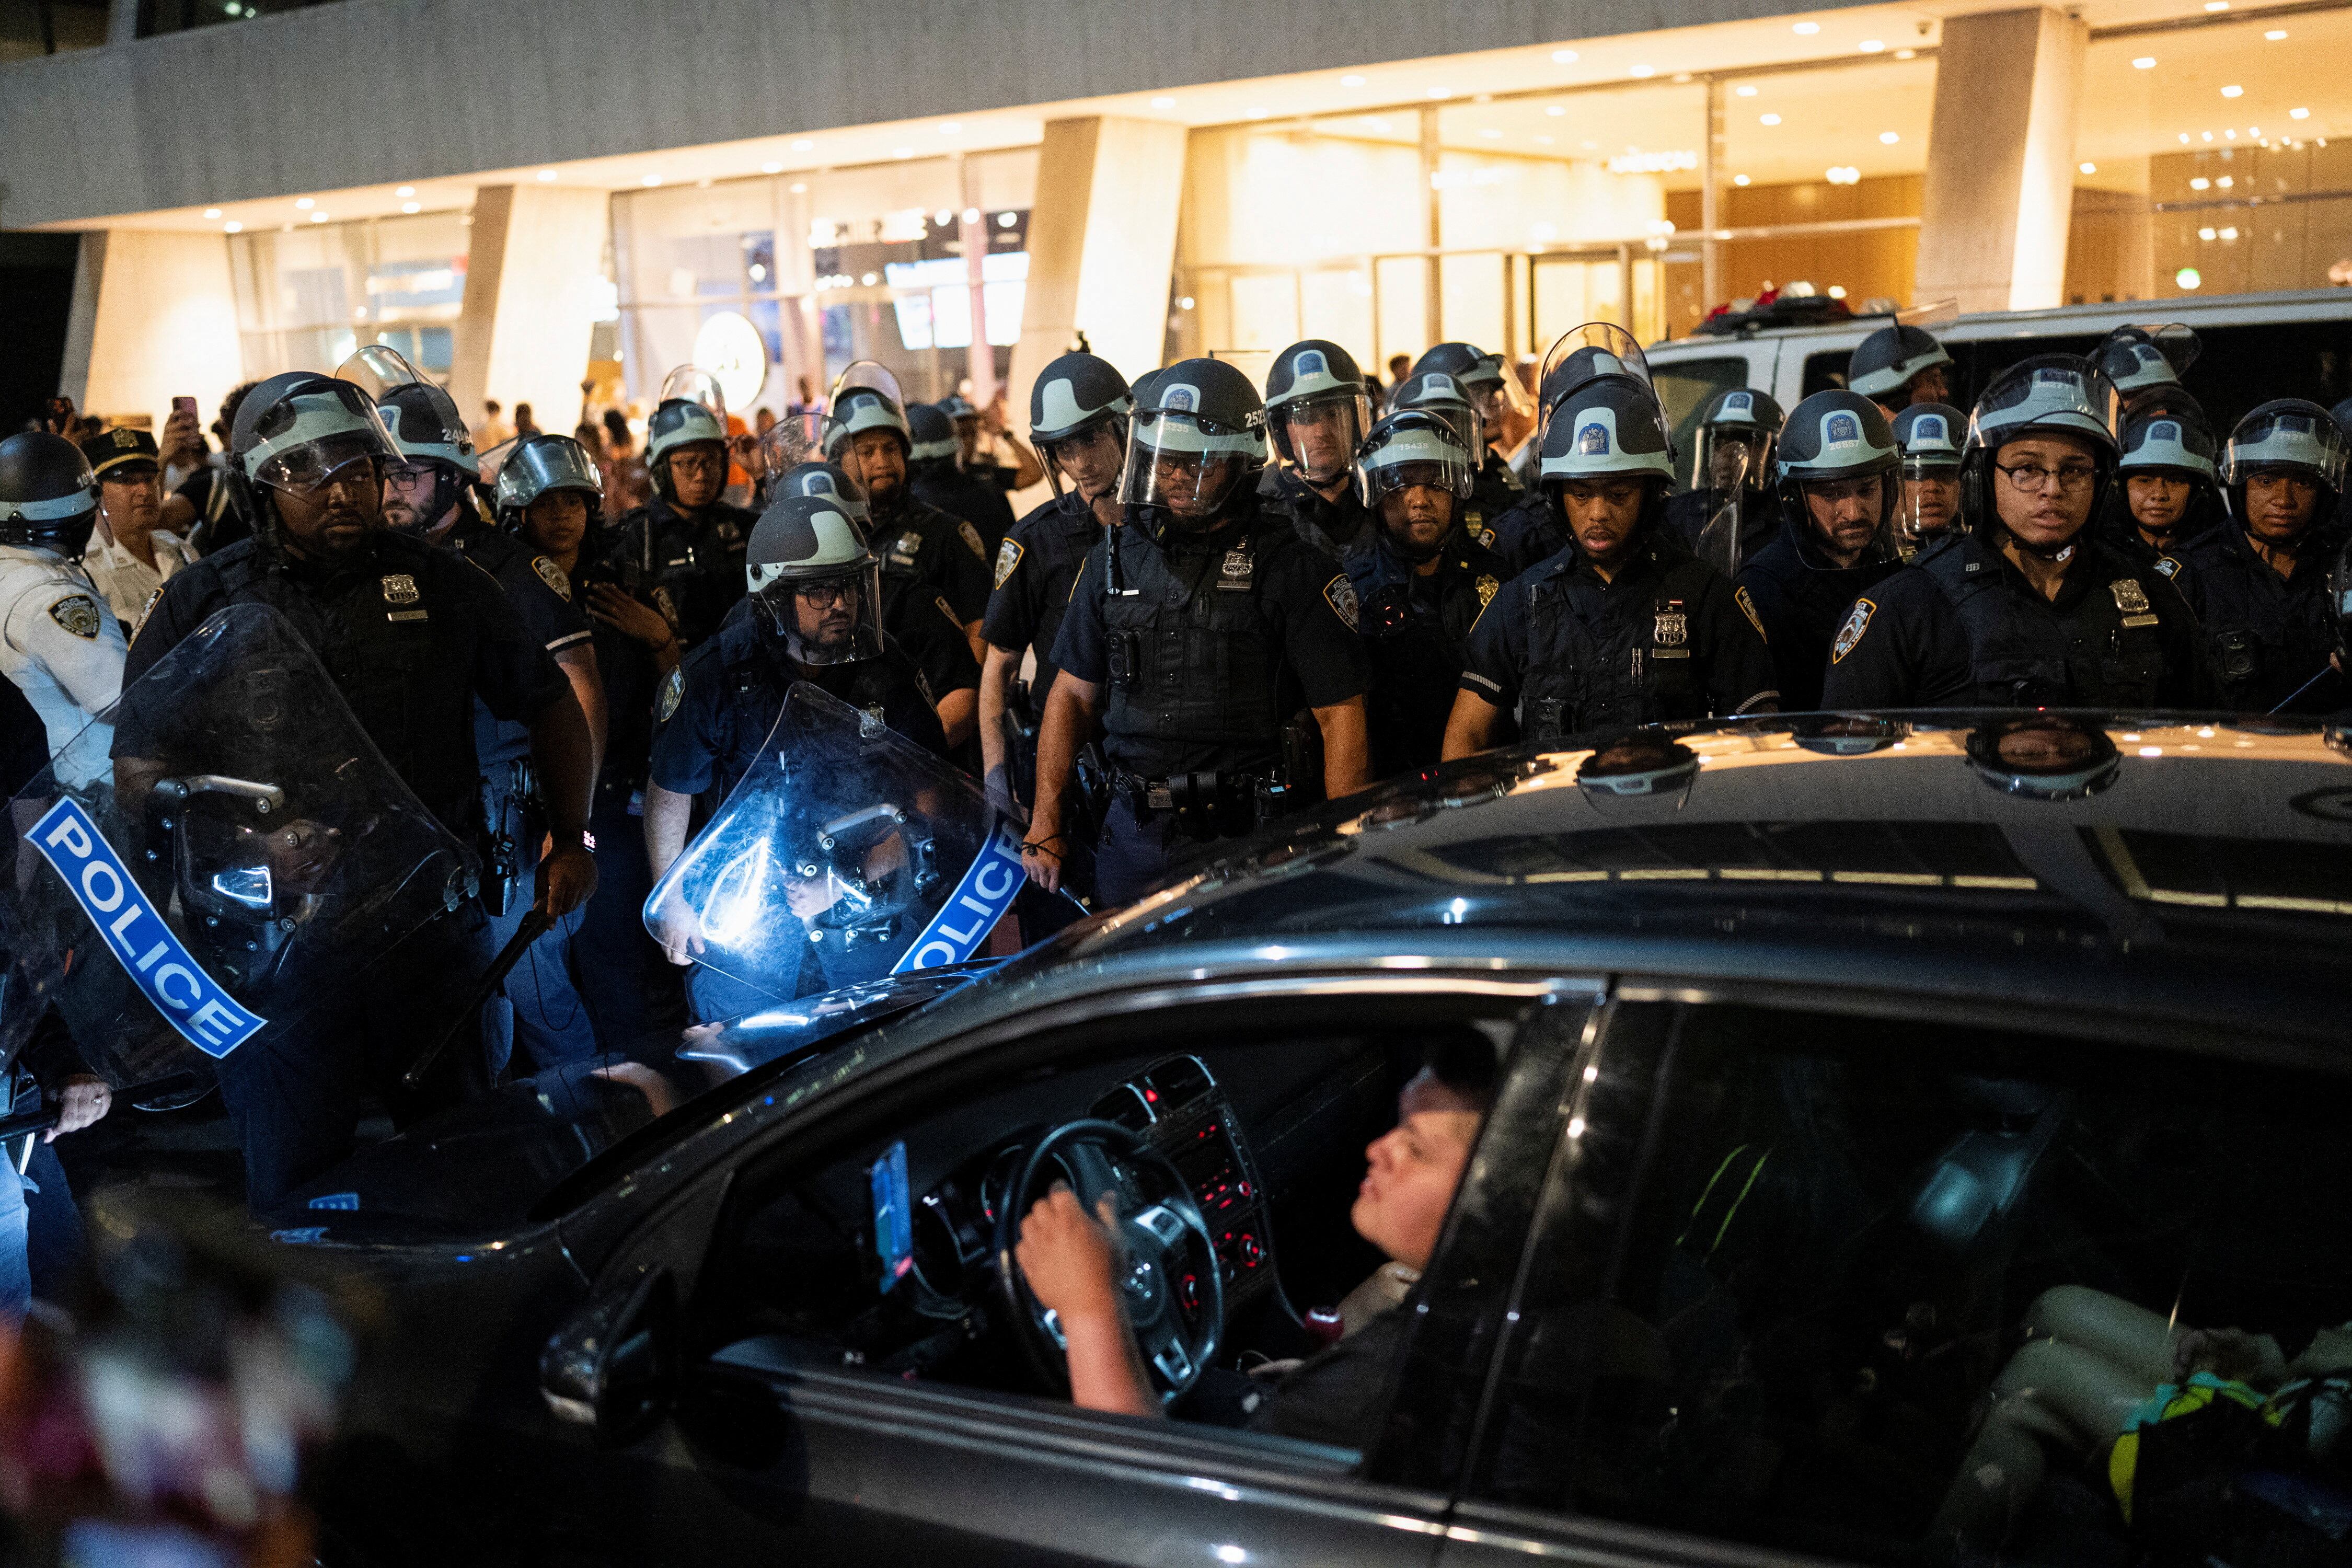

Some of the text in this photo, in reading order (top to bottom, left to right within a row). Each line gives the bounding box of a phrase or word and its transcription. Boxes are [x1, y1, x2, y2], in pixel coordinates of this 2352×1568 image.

[1829, 440, 1860, 451] 26867
[1333, 578, 1348, 590] POLICE
[1338, 607, 1348, 619] CITY
[913, 822, 1023, 970] OLICE
[47, 815, 244, 1047] POLICE
